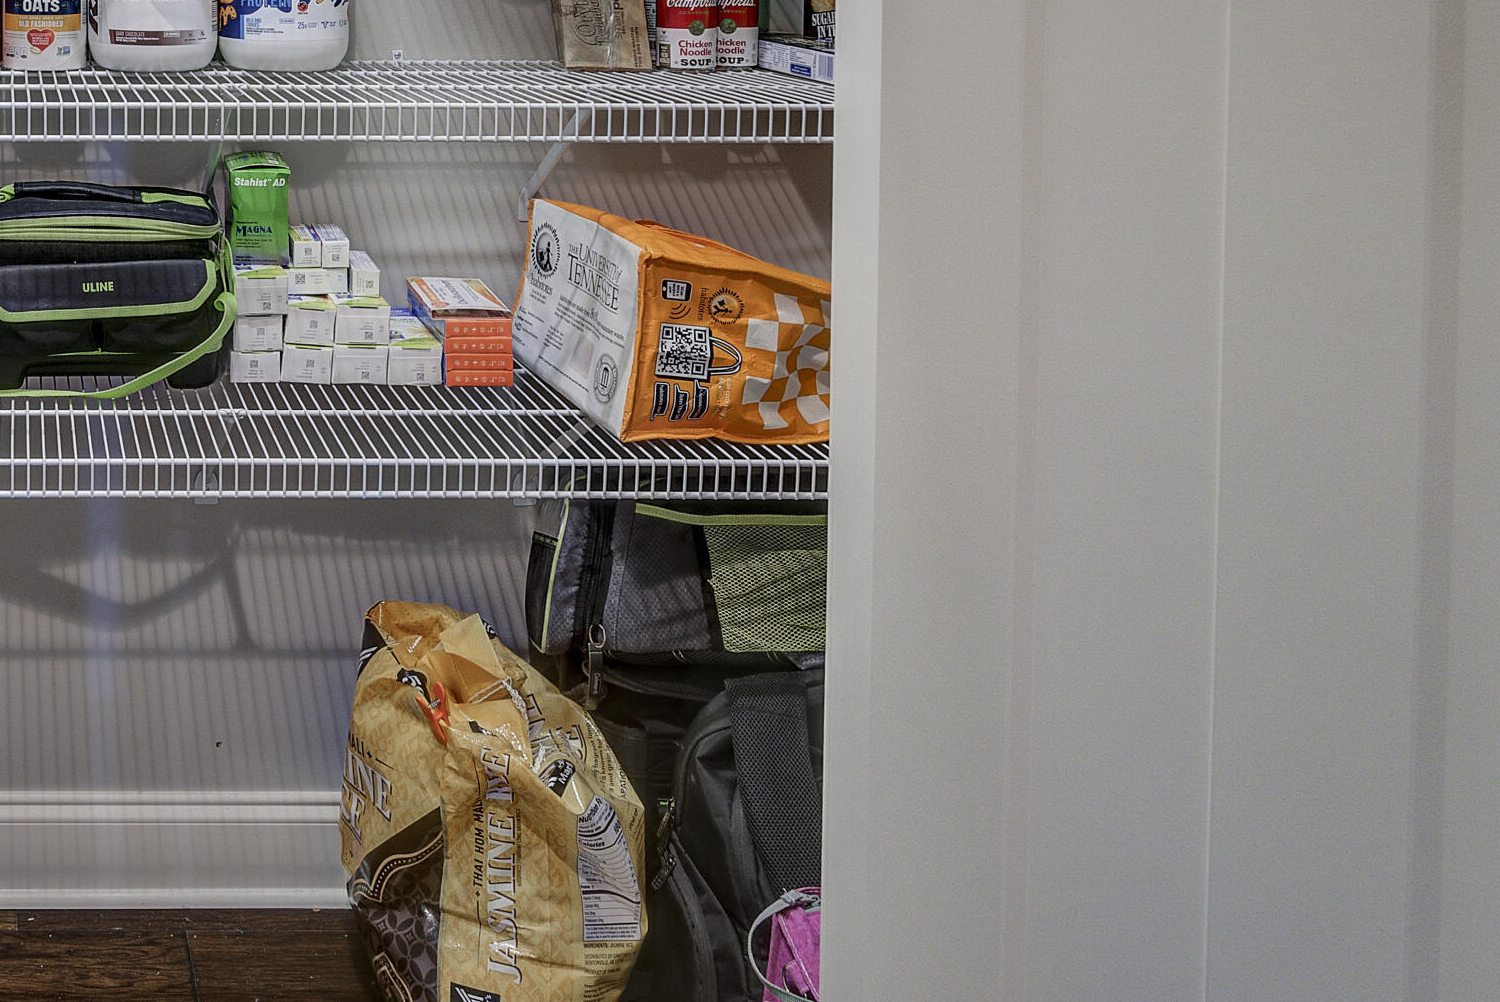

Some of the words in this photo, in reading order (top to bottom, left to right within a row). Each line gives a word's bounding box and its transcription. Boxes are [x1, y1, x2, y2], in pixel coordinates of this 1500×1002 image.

[22, 0, 60, 13] OATS
[30, 20, 64, 28] FASHIONED
[678, 39, 713, 48] Chicken
[717, 38, 746, 47] hicken
[679, 48, 712, 56] Noodle
[680, 58, 712, 66] SOUP
[272, 178, 286, 187] AD
[235, 225, 273, 237] MAGNA
[568, 244, 579, 254] THE
[568, 253, 619, 311] TENNESSEE
[82, 282, 114, 293] ULINE
[474, 829, 485, 856] HOM
[472, 860, 483, 887] THAI
[487, 812, 522, 985] JASMINE
